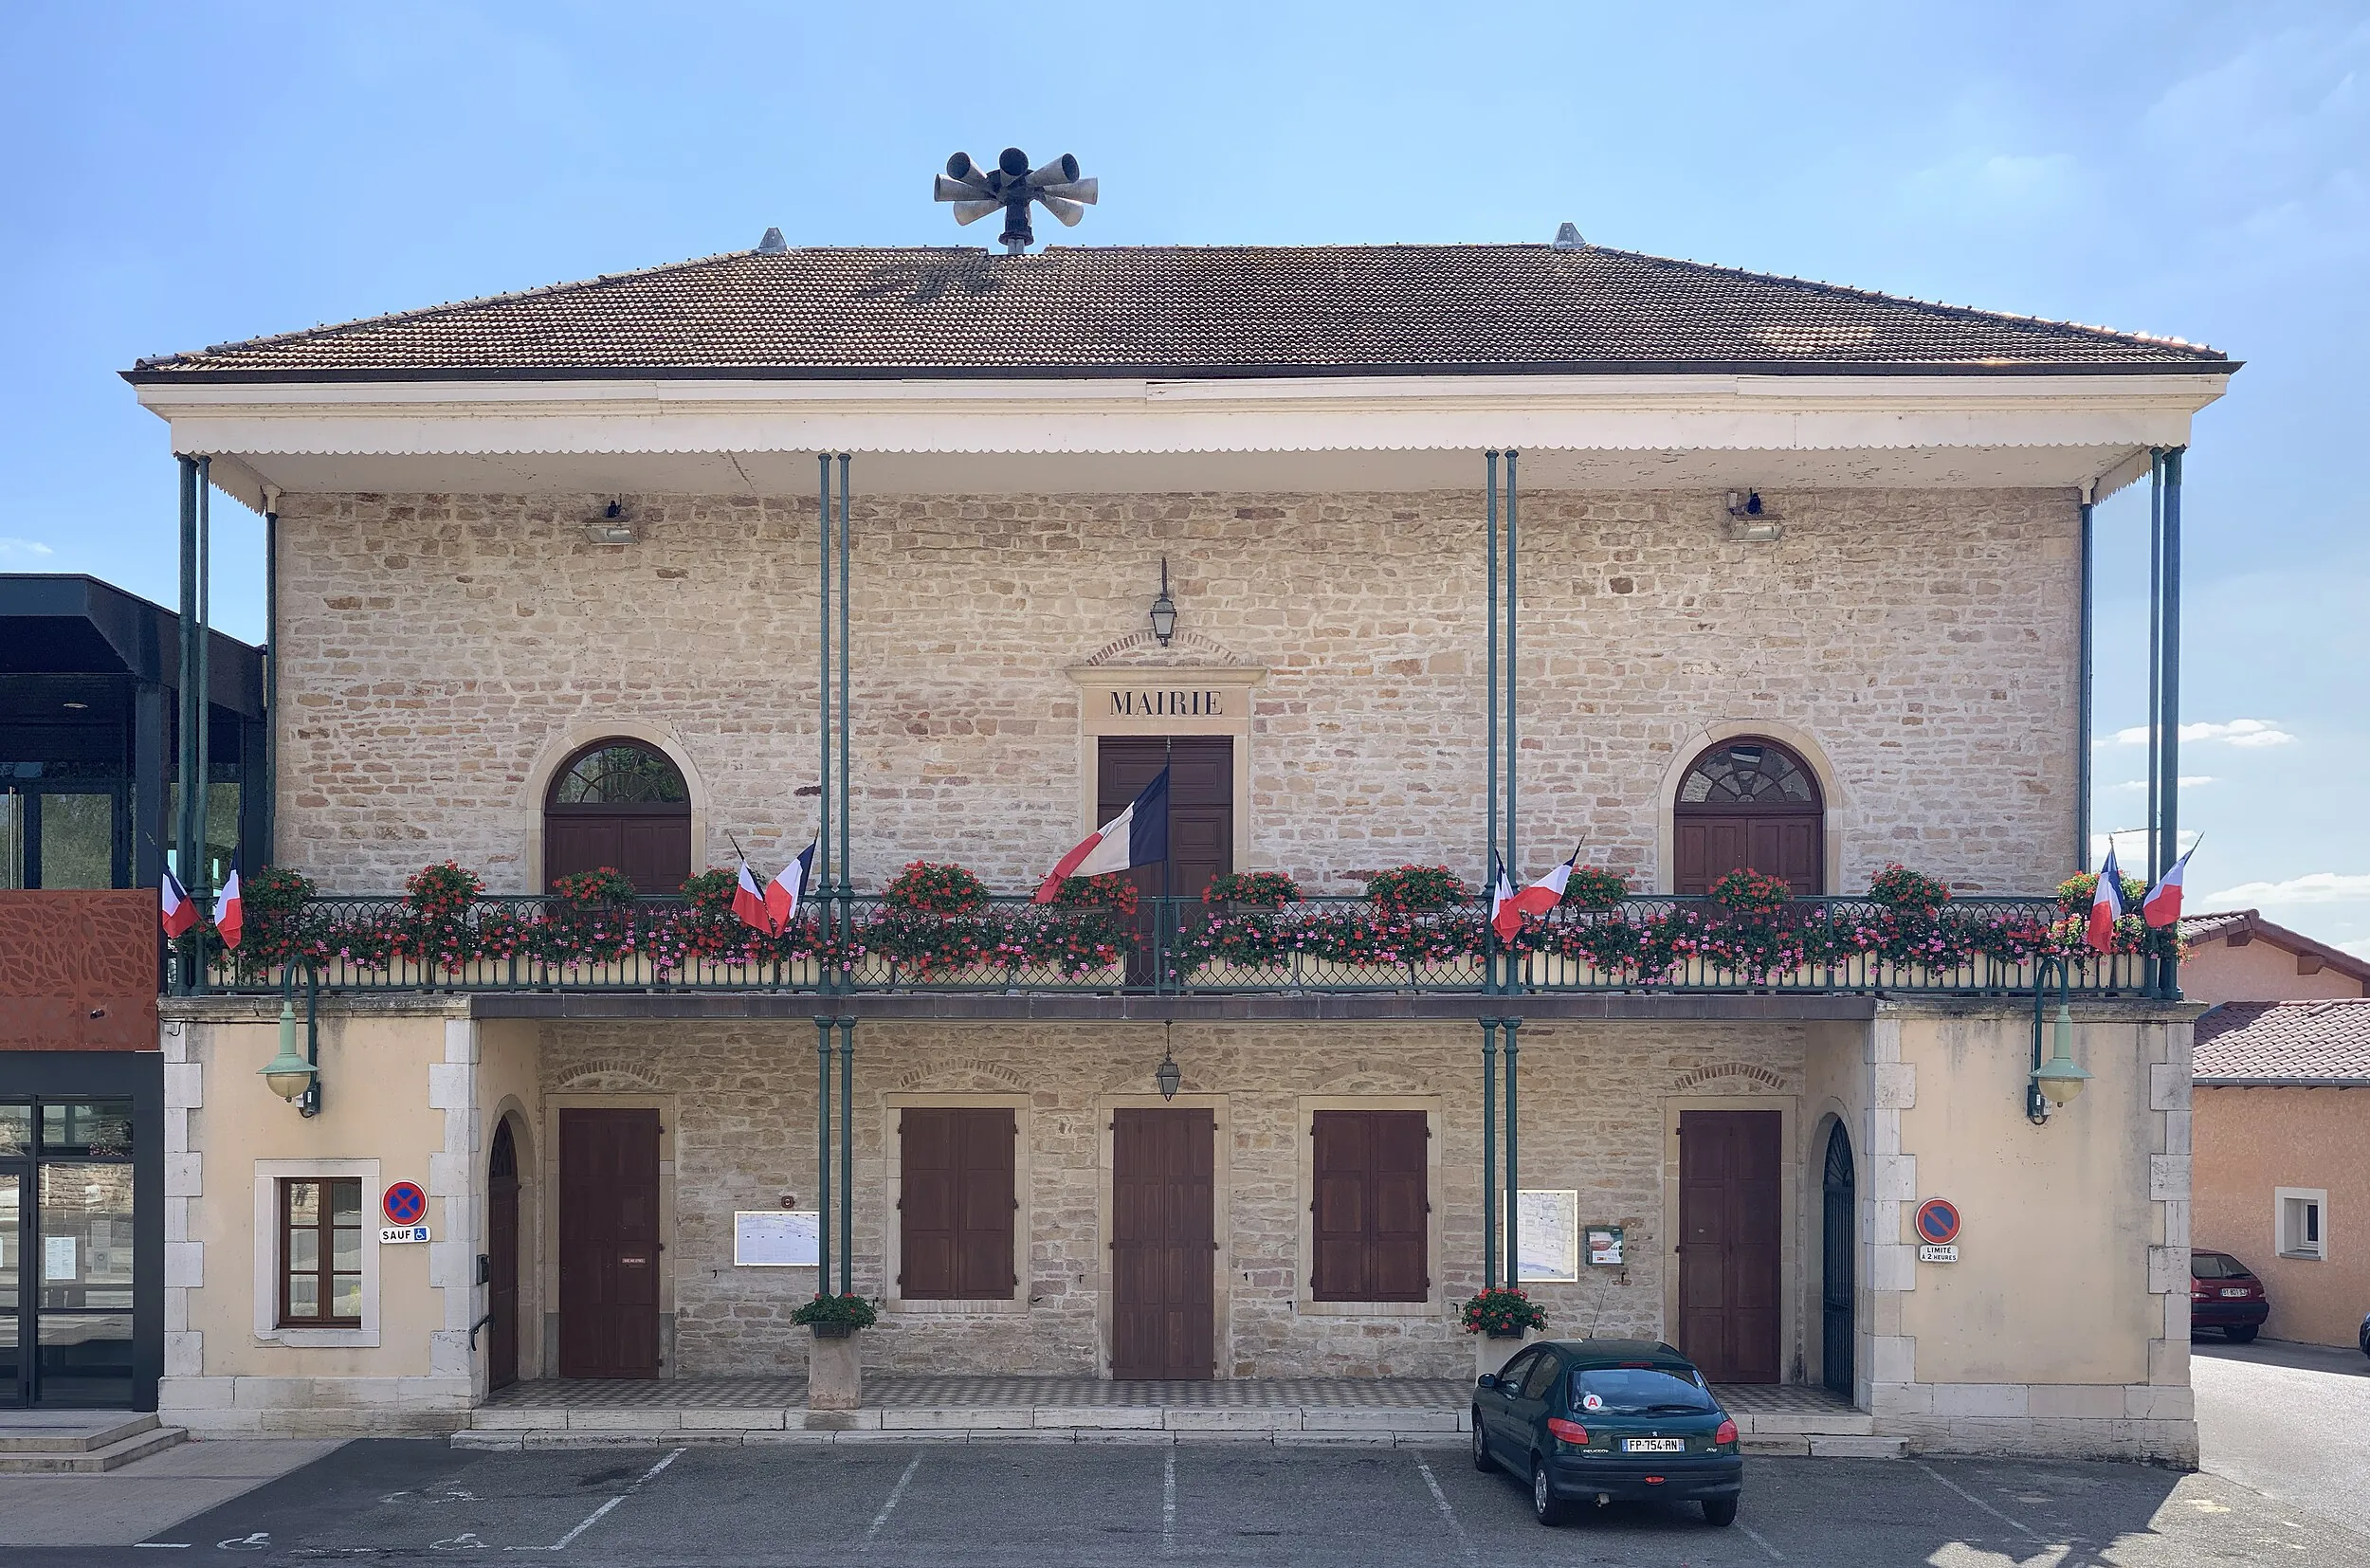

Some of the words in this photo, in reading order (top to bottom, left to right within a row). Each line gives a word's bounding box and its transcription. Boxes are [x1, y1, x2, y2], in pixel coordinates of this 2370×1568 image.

[1110, 691, 1223, 716] MAIRIE
[382, 1230, 410, 1240] SAUF
[1587, 1396, 1598, 1407] A
[1630, 1440, 1677, 1450] FP-754-RN
